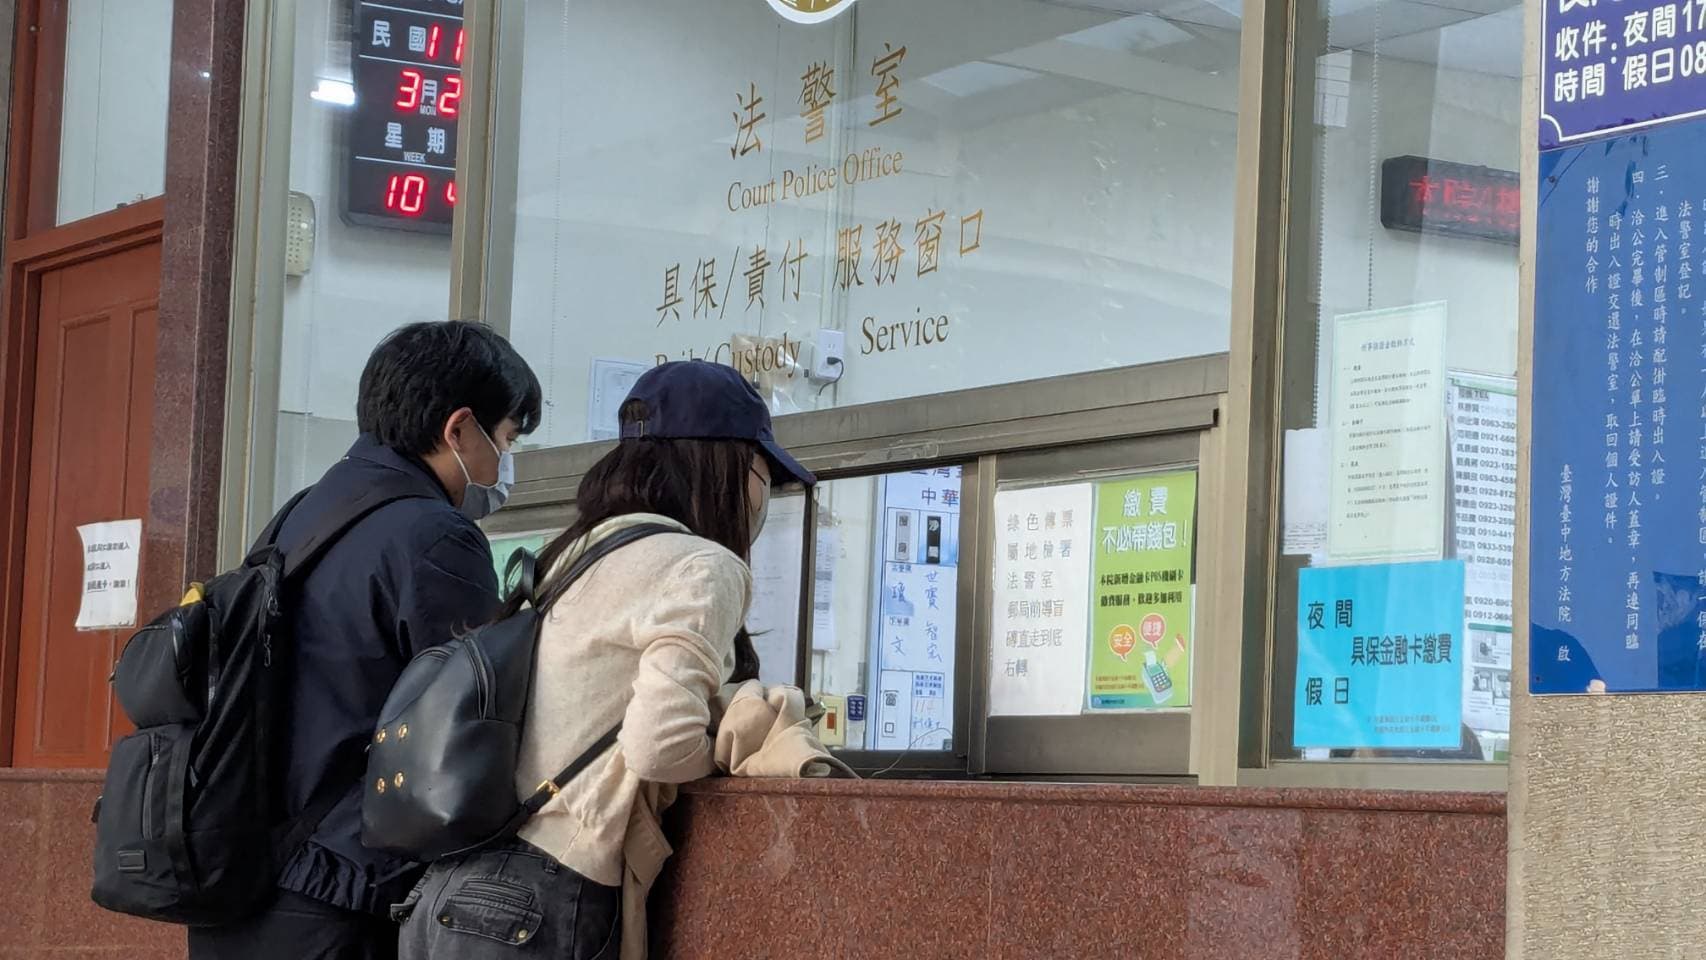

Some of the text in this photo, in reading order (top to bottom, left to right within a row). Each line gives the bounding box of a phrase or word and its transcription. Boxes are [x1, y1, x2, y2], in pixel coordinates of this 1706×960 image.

[1554, 63, 1606, 102] 時間
[420, 105, 437, 116] MON
[730, 43, 906, 160] 法警室
[384, 122, 445, 154] 星期
[403, 152, 426, 164] WEEK
[387, 176, 424, 212] 10
[727, 147, 904, 212] Court Police Office
[1585, 176, 1600, 294] 謝謝您的合作
[655, 207, 983, 328] 具保/責付 服務窗口
[861, 307, 951, 355] Service
[1123, 486, 1168, 518] 繳費
[1006, 571, 1053, 591] 法警室
[1307, 599, 1353, 630] 夜間
[1351, 633, 1451, 666] 具保金融卡繳費
[1004, 658, 1028, 678] 右轉
[1306, 677, 1350, 706] 假日
